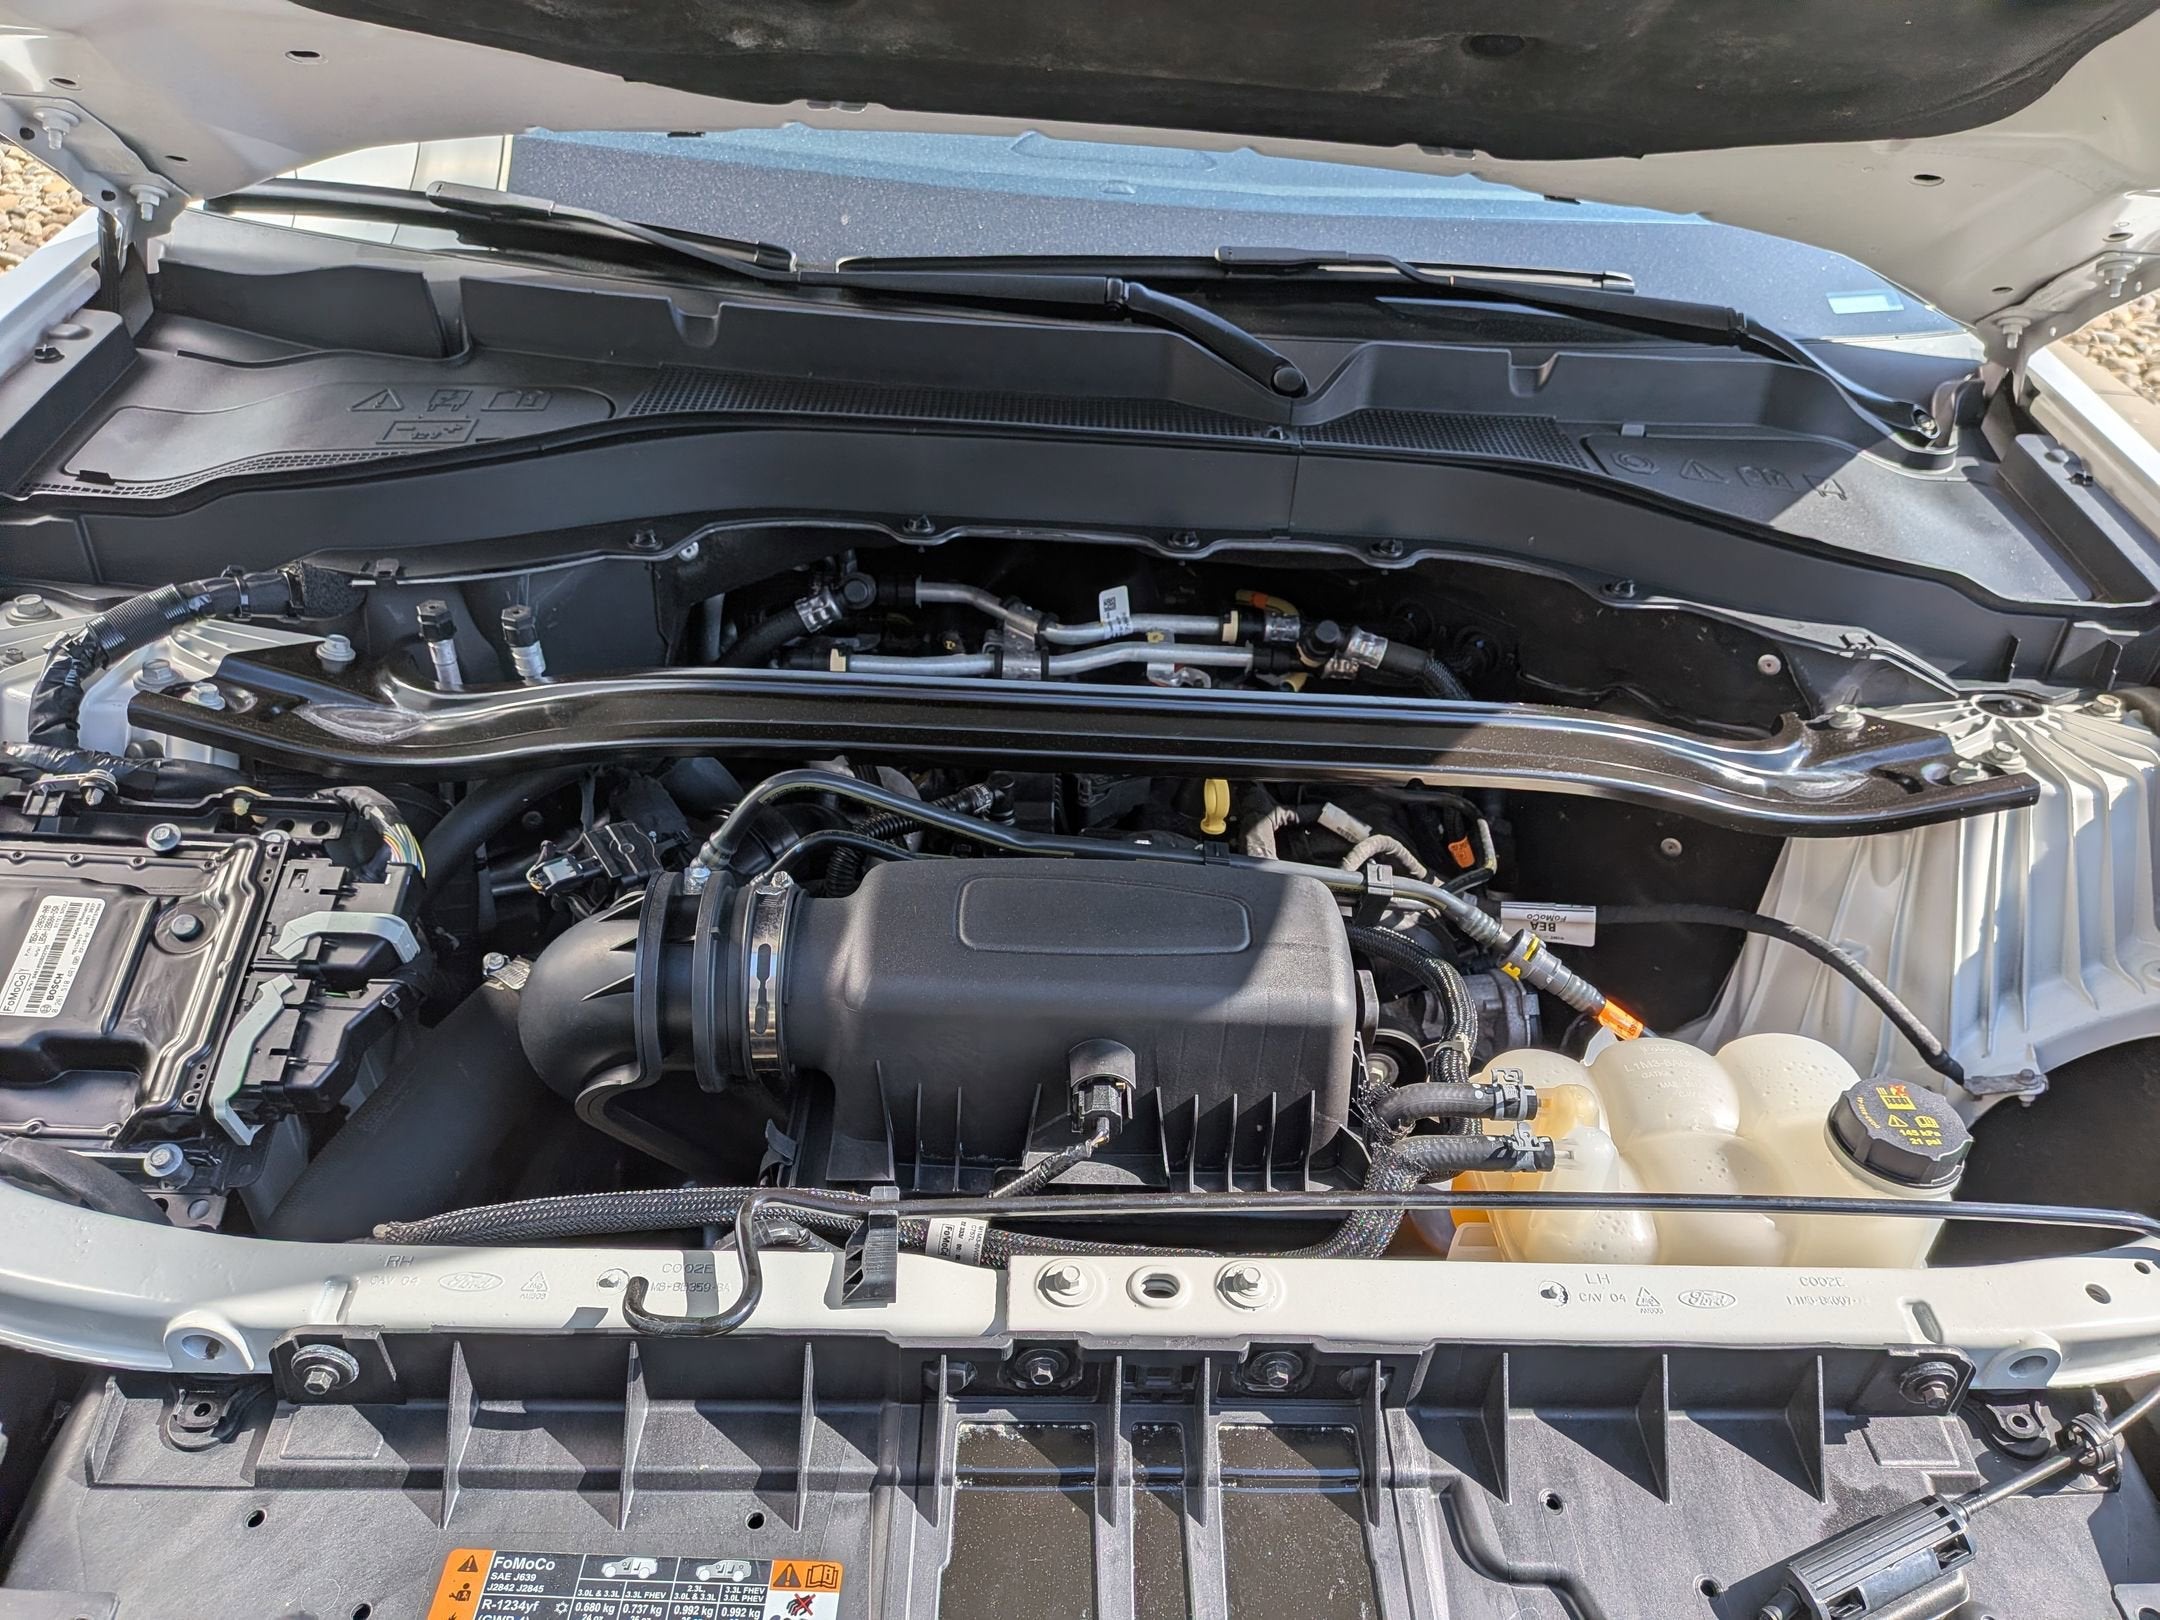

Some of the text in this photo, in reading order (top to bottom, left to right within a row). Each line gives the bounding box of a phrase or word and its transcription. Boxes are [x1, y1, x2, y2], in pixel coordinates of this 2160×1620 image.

[1527, 913, 1568, 923] FoMoCo
[1530, 921, 1556, 932] BEA
[3, 975, 26, 1012] FoMoCo
[47, 973, 64, 1001] BOSCH
[941, 1226, 953, 1256] FoMoCo
[385, 1255, 415, 1268] RH
[445, 1273, 497, 1290] Ford
[1585, 1273, 1611, 1285] LH
[1610, 1293, 1626, 1303] 04
[1686, 1291, 1728, 1307] Ford
[493, 1556, 556, 1570] FoMoCo
[491, 1572, 537, 1582] SAE J639
[487, 1583, 544, 1593] J2842 J2845
[577, 1589, 593, 1597] 3.0L
[603, 1590, 620, 1598] 3.3L
[725, 1586, 766, 1595] 3.3L FHEV
[624, 1591, 666, 1600] 3.3L FHEV
[674, 1592, 716, 1601] 3.0L & 3.3L
[723, 1593, 764, 1602] 3.0L PHEV
[482, 1599, 540, 1614] R-1234yf
[575, 1602, 616, 1615] 0.680 kg
[623, 1604, 662, 1617] 0.737 kg
[674, 1605, 713, 1618] 0.992 kg
[721, 1607, 760, 1620] 0.992 kg
